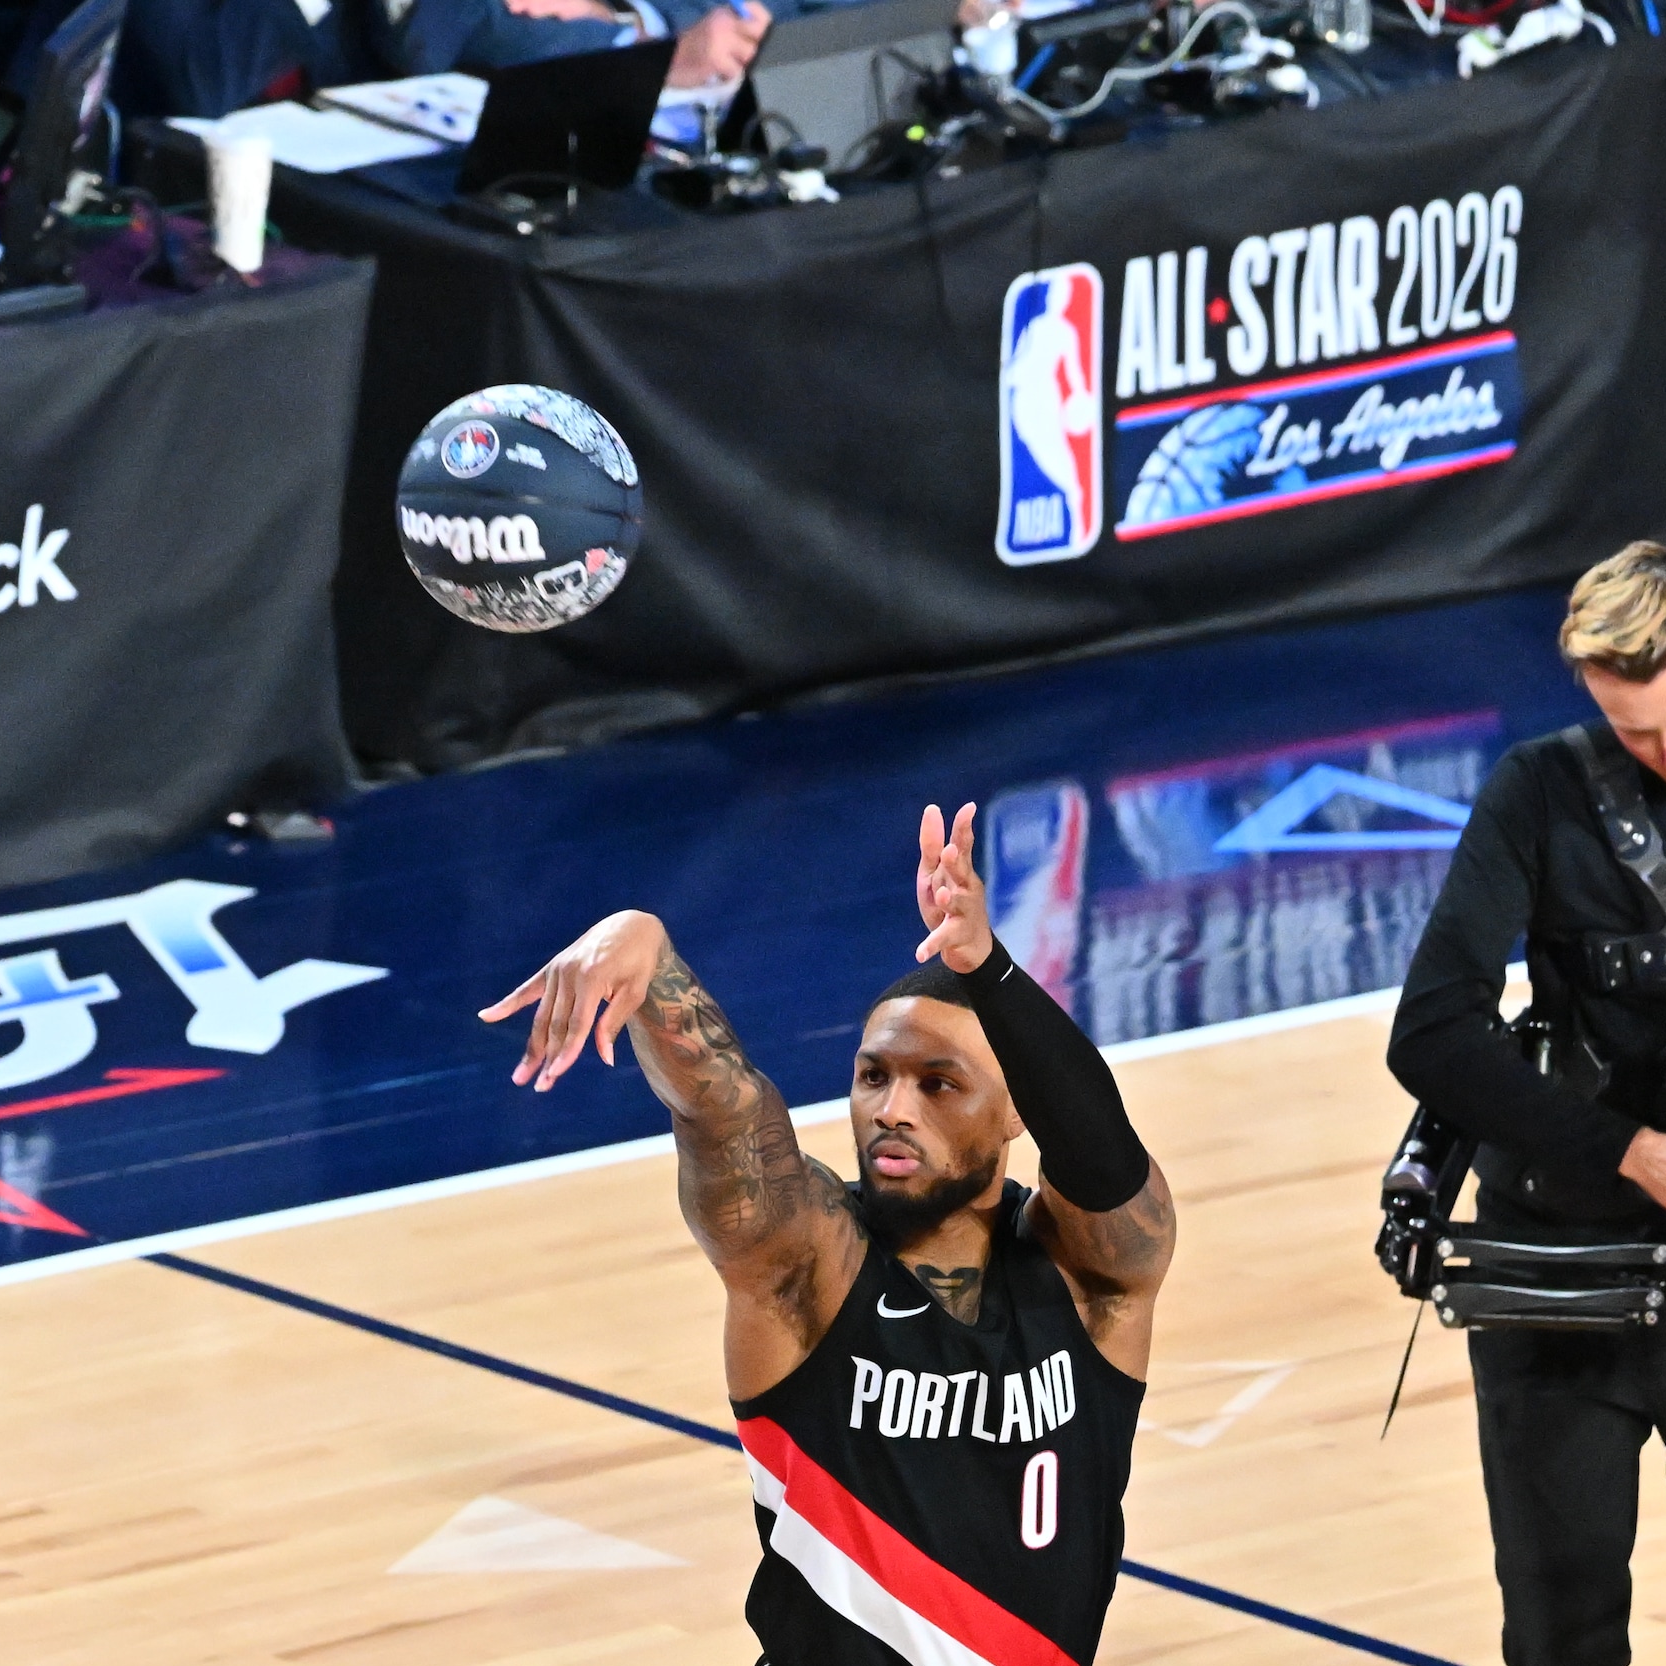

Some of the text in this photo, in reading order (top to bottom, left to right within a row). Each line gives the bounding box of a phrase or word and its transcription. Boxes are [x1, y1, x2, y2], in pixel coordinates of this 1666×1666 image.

[1385, 185, 1524, 347] 2026
[1245, 366, 1503, 477] Los Angeles
[400, 505, 546, 564] Wilson
[850, 1349, 1076, 1444] PORTLAND
[1020, 1449, 1059, 1550] 0
